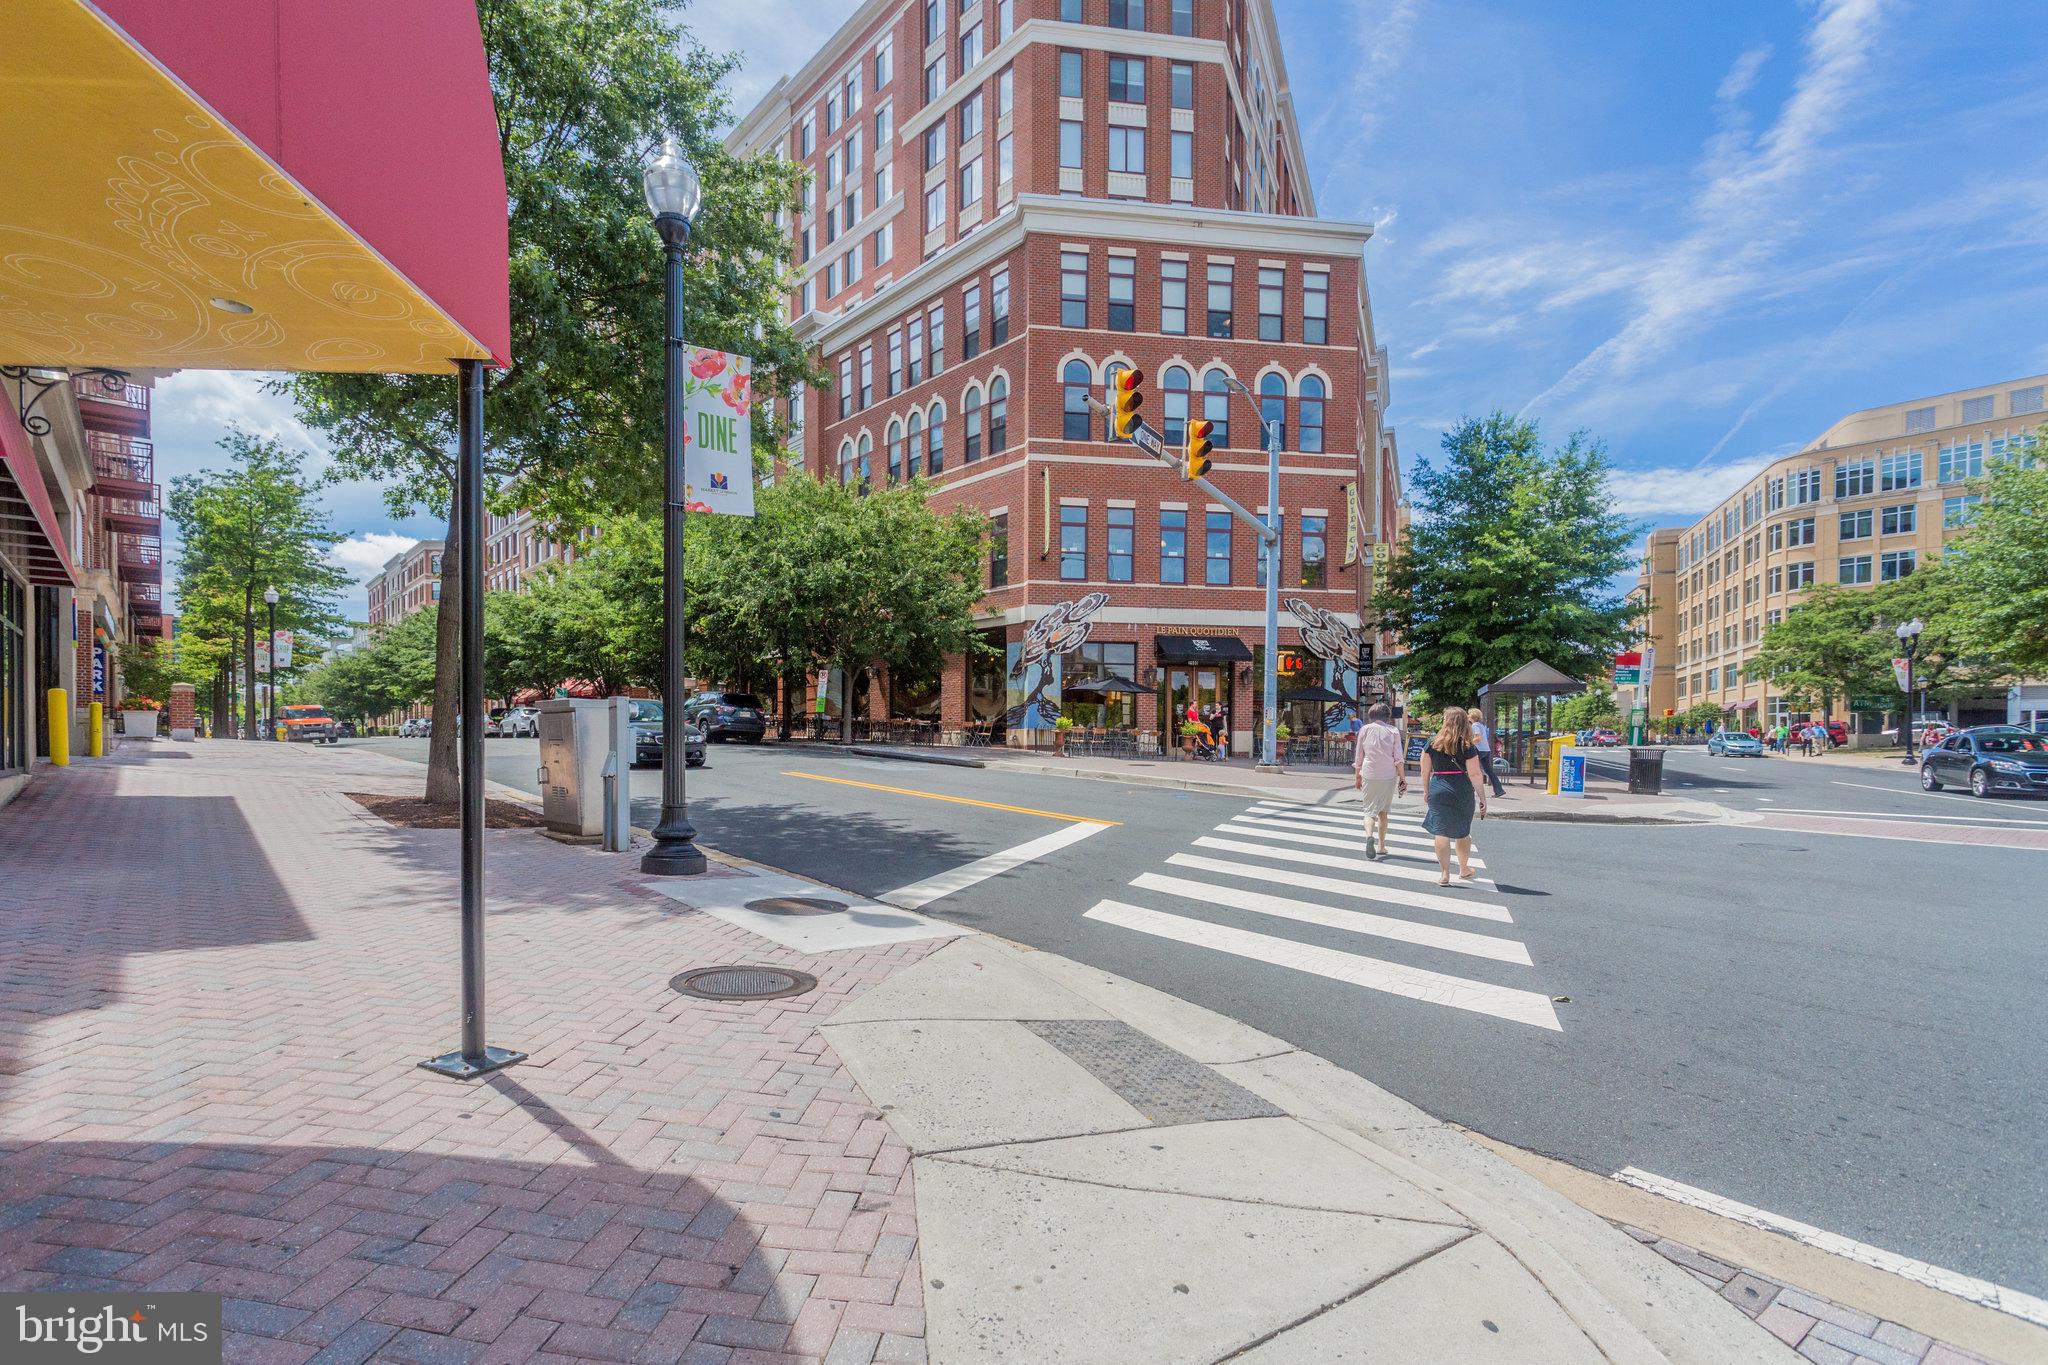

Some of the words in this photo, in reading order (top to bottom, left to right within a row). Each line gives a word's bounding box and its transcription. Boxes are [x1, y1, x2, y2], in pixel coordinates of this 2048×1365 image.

[697, 411, 738, 455] DINE
[1156, 625, 1166, 634] LE
[1168, 626, 1188, 635] PAIN
[1190, 626, 1239, 636] QUOTIDIEN
[93, 647, 103, 692] PARK
[1295, 657, 1302, 669] 6
[1562, 759, 1570, 789] APARTMENT
